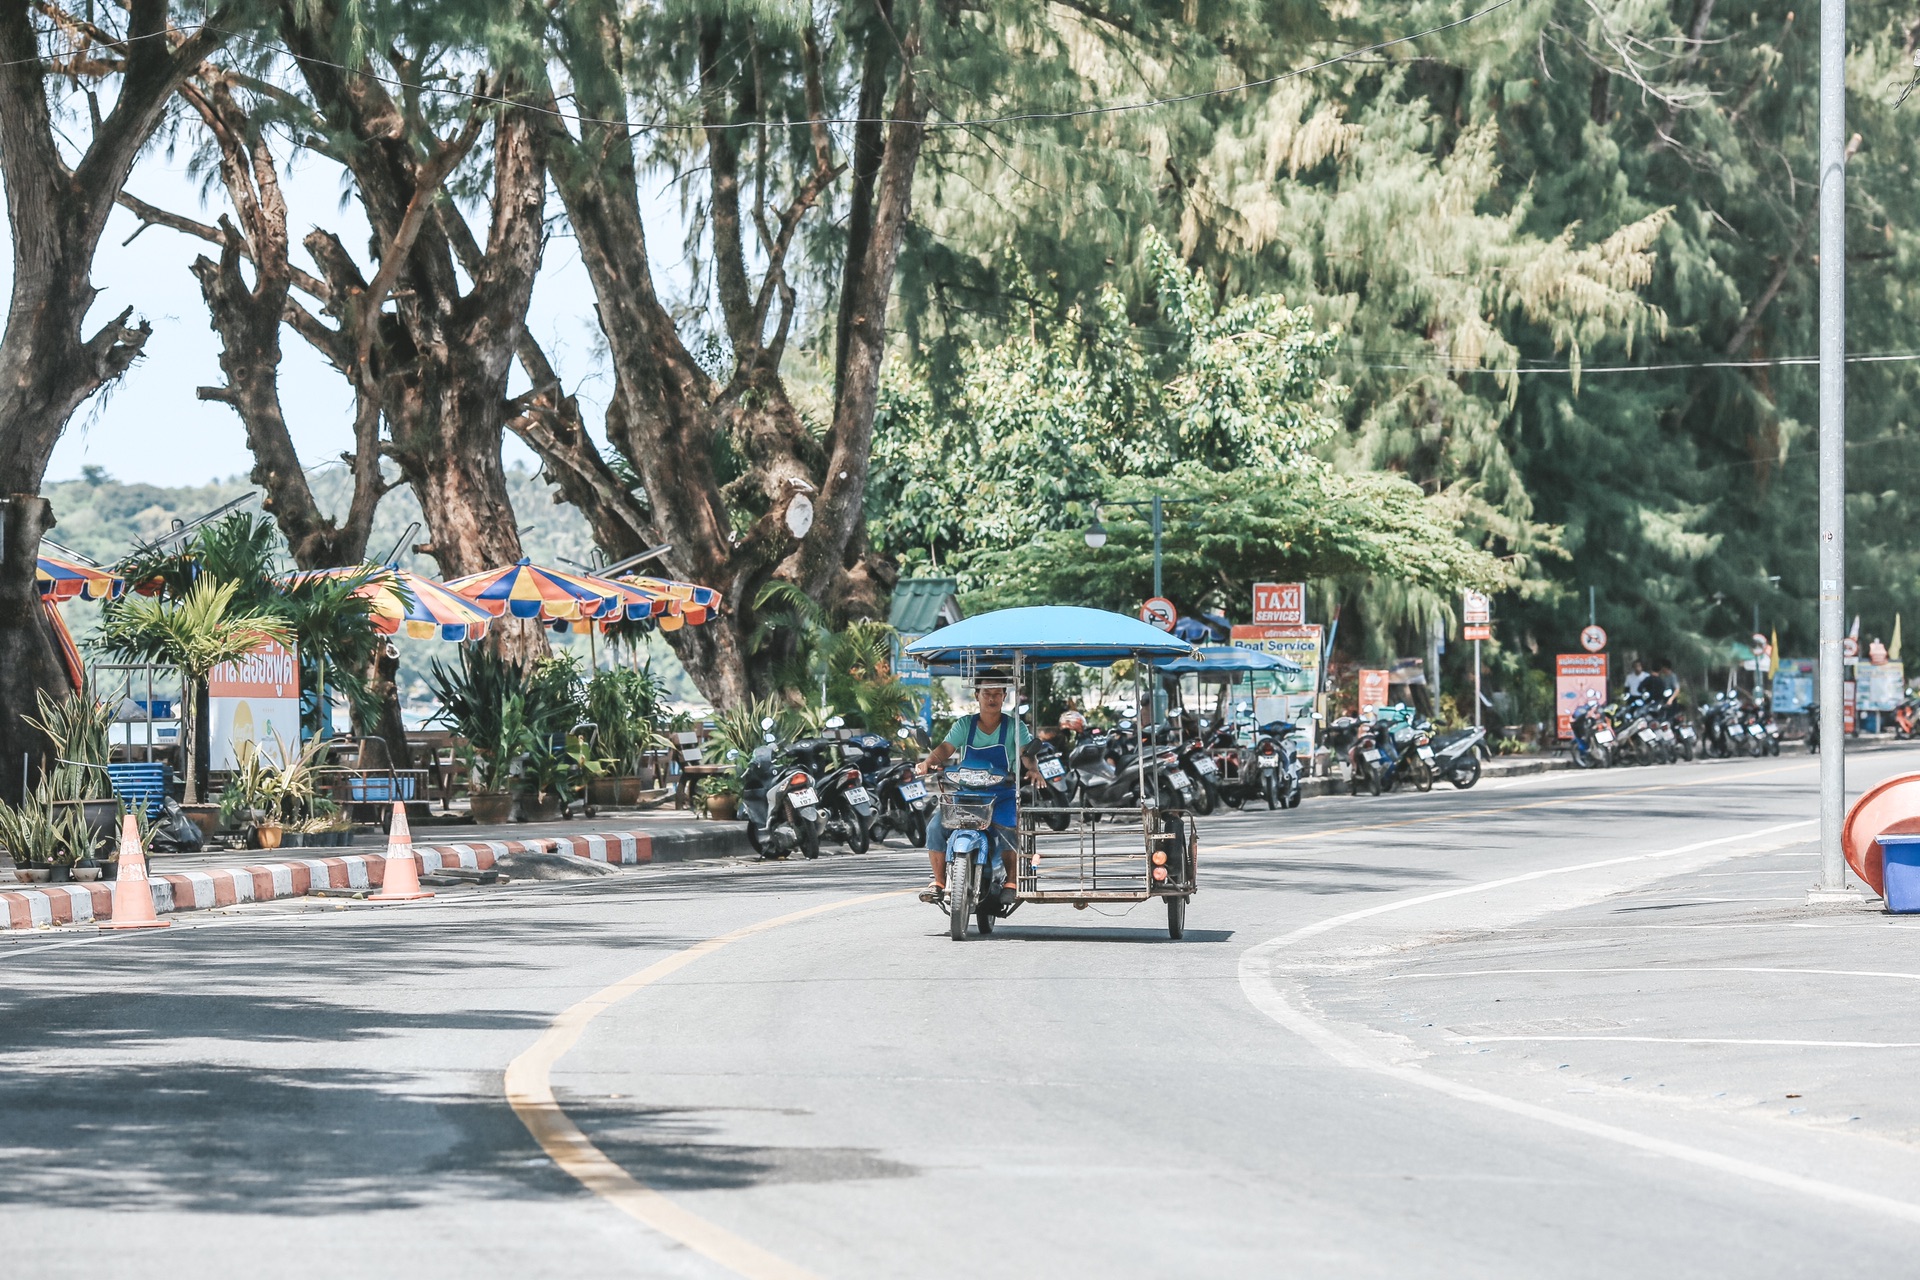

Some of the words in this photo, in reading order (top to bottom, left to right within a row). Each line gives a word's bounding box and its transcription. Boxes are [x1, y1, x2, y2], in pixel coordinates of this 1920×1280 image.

[1257, 592, 1299, 609] TAXI
[1256, 611, 1300, 621] SERVICES
[1234, 641, 1264, 651] Boat
[1268, 641, 1315, 651] Service
